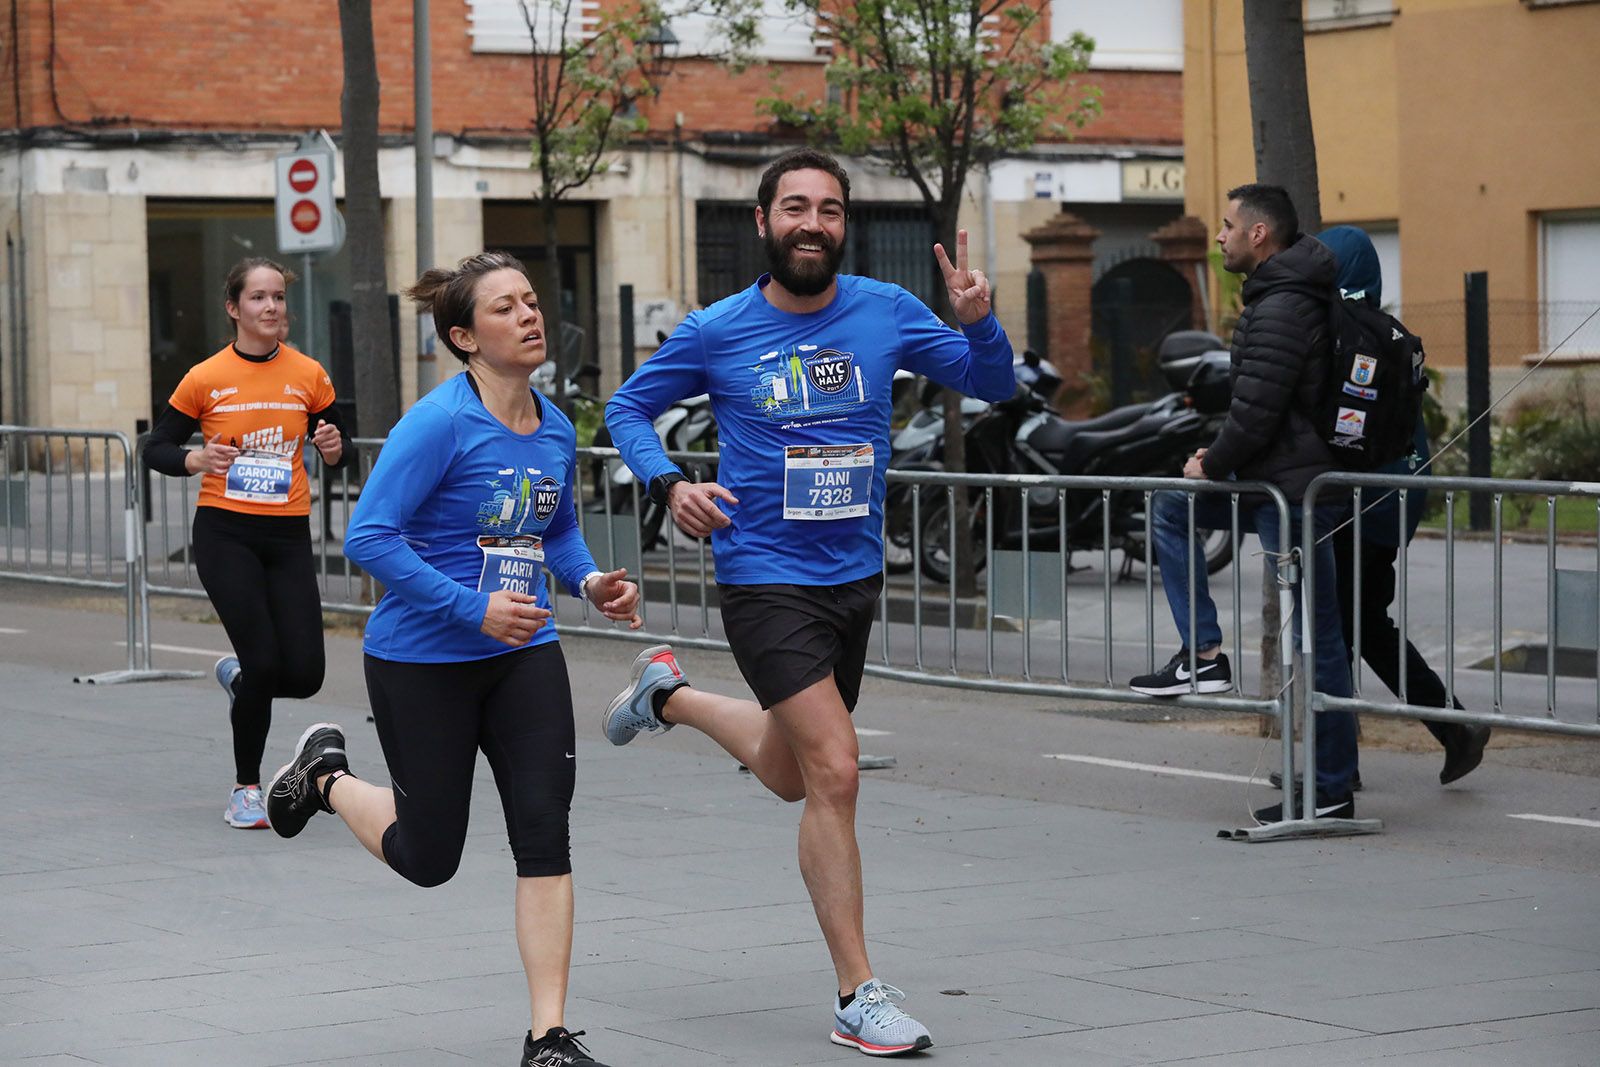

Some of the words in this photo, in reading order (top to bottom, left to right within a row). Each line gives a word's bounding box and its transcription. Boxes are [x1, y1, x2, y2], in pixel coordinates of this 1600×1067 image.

[815, 362, 845, 378] NYC
[818, 375, 844, 386] HALF
[237, 466, 285, 481] CAROLIN
[815, 471, 850, 486] DANI
[243, 478, 276, 492] 7241
[537, 492, 557, 504] NYC
[808, 487, 853, 506] 7328
[537, 504, 555, 513] HALF
[498, 559, 533, 578] MARTA
[500, 577, 529, 596] 7081
